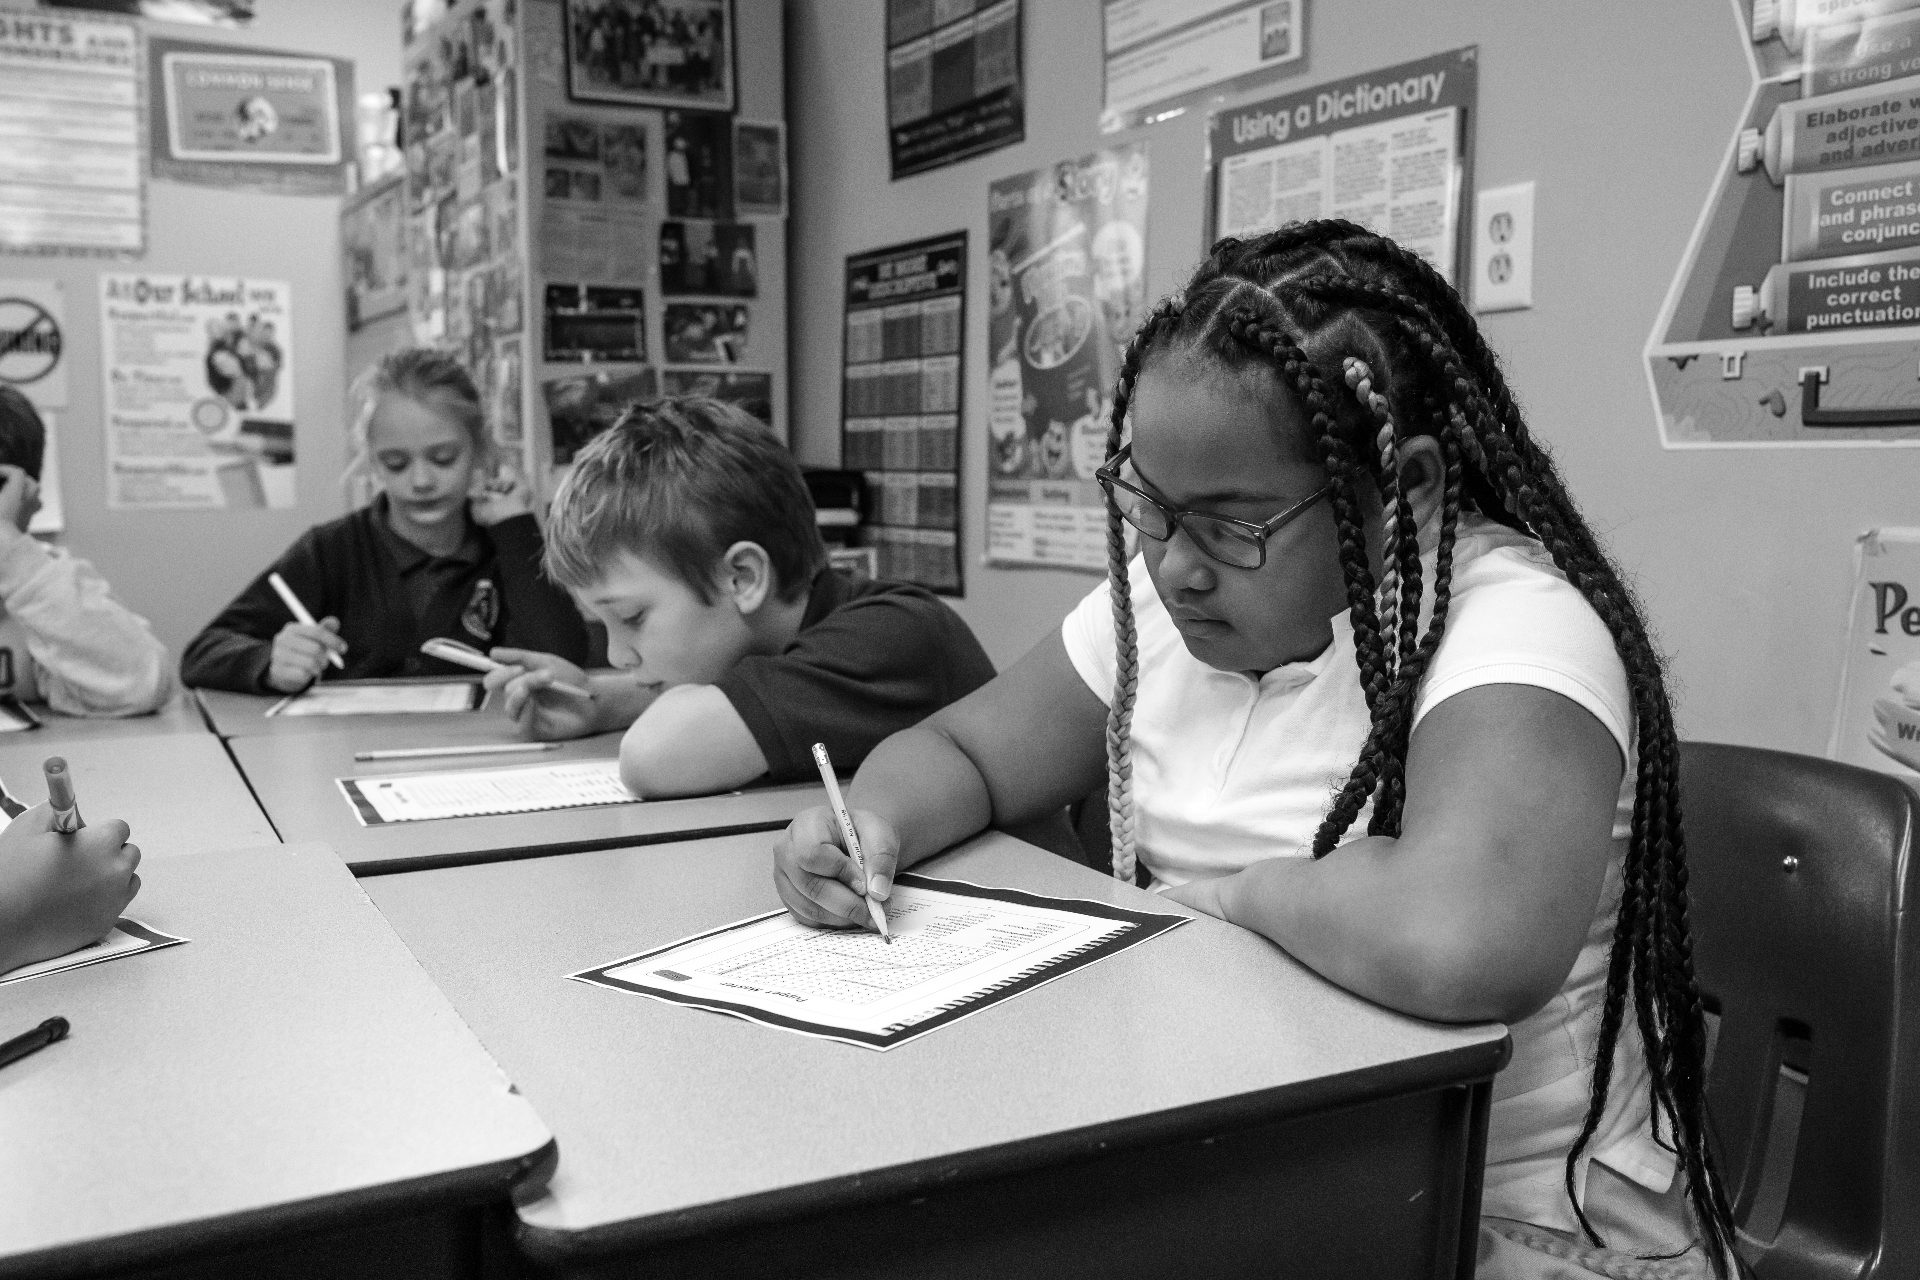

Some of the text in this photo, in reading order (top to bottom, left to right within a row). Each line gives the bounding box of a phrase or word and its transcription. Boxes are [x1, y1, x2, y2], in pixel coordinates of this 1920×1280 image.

[1827, 63, 1892, 87] strong
[1232, 71, 1446, 144] Using a Dictionary
[1806, 100, 1902, 128] Elaborate
[1826, 117, 1919, 144] adjective
[1819, 135, 1920, 165] and adver
[1830, 181, 1913, 206] Connect
[1819, 207, 1855, 227] and
[1808, 264, 1920, 290] Include the
[1826, 285, 1901, 307] correct
[1868, 581, 1920, 637] Pe
[1897, 721, 1920, 742] W
[719, 982, 809, 1003] Puppet Master
